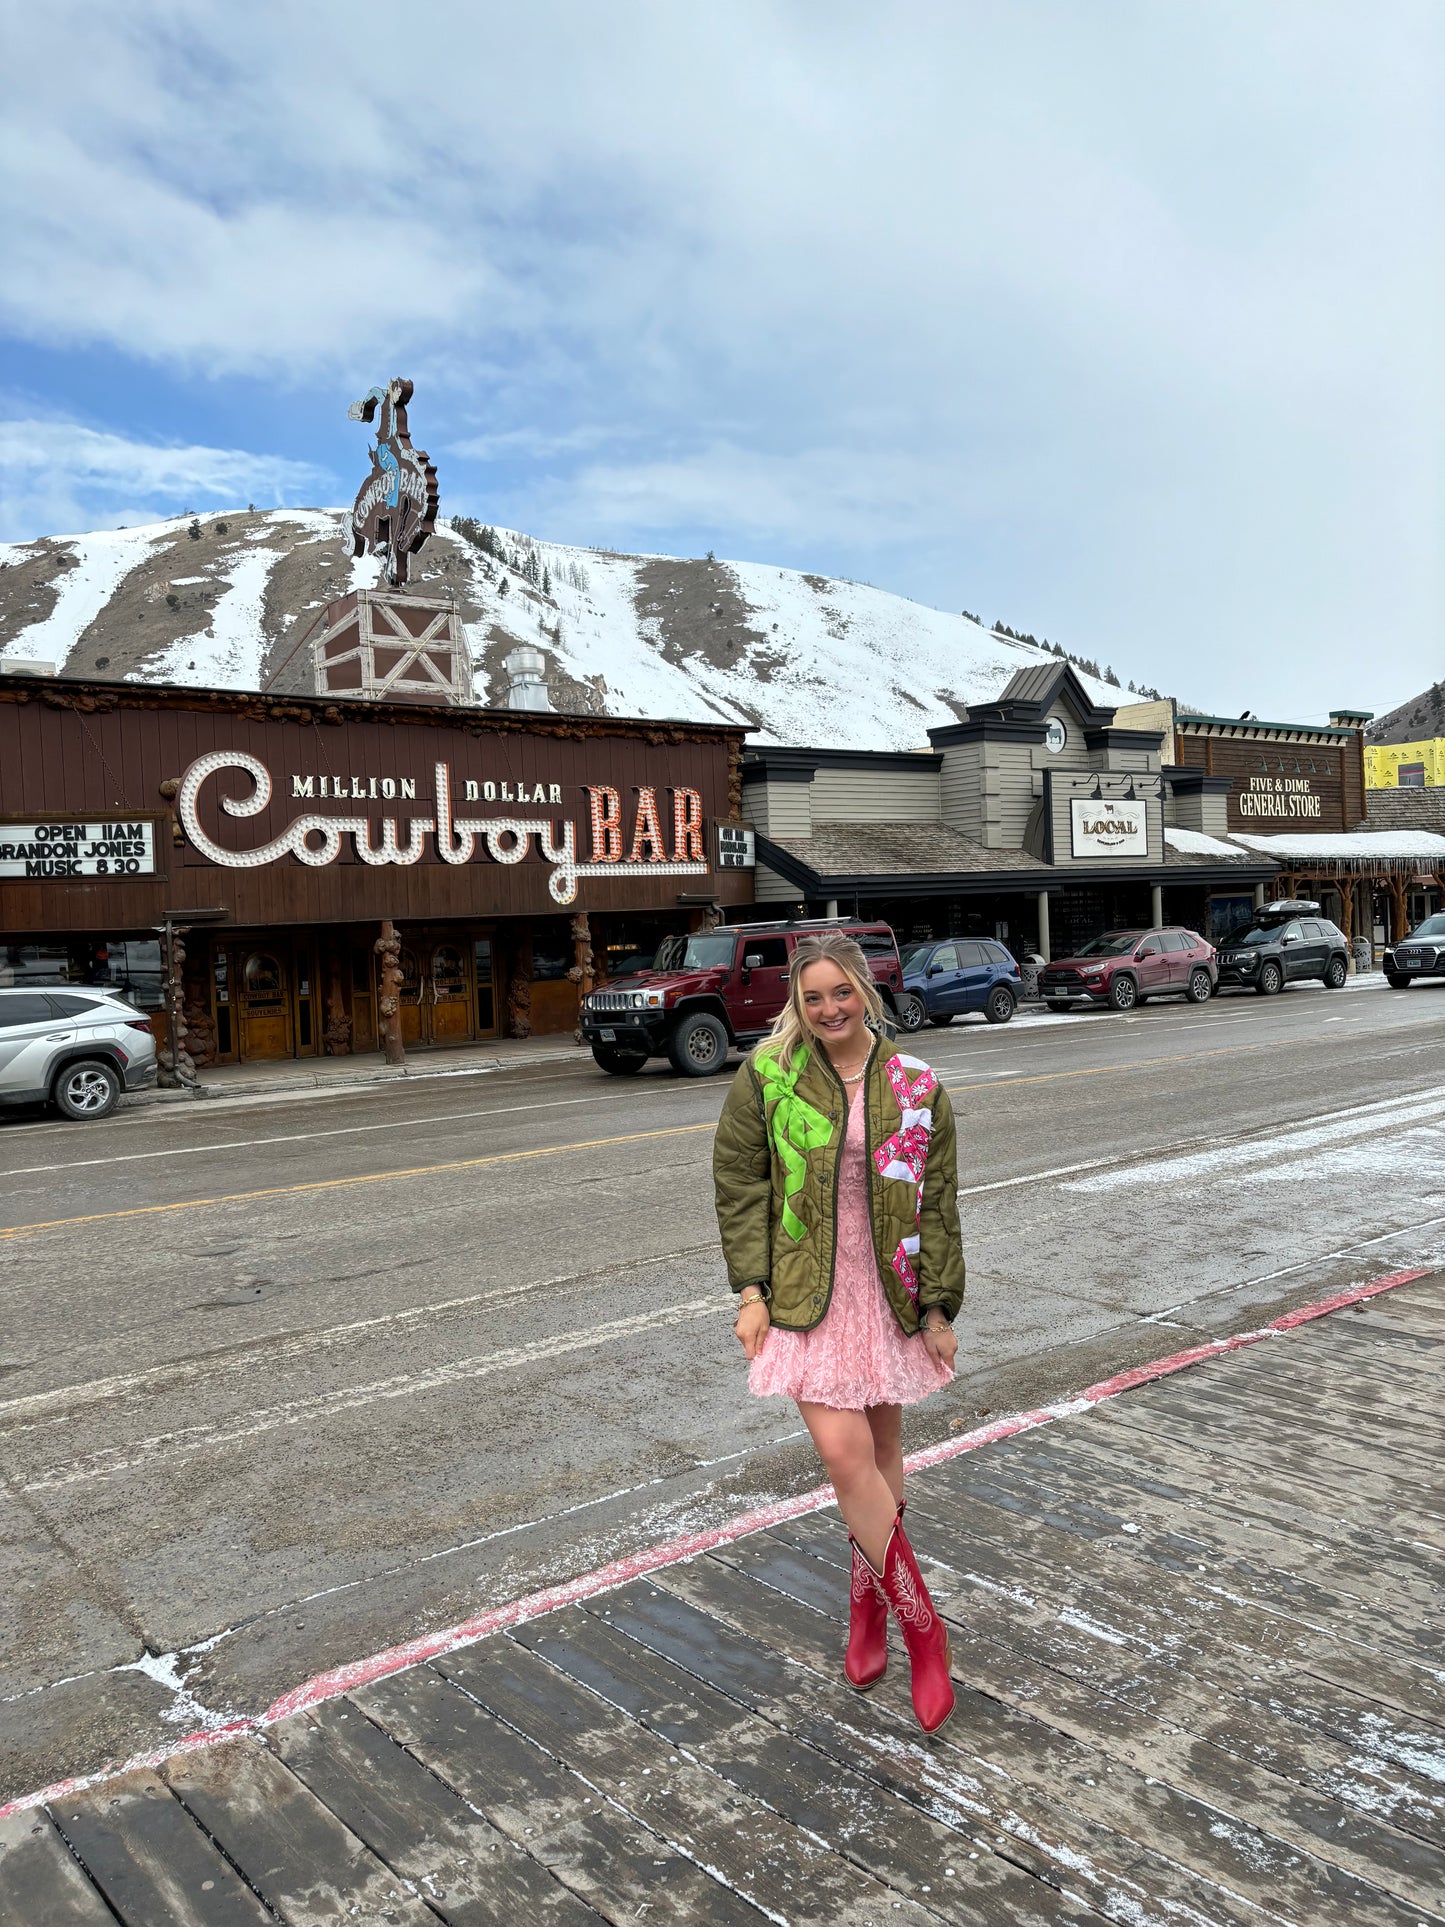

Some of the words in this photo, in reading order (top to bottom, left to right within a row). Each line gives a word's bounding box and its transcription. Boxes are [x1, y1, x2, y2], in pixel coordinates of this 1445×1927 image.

[354, 470, 398, 528] COWBOY
[399, 468, 426, 505] BAR
[291, 775, 416, 799] MILLION
[465, 780, 562, 804] DOLLAR
[1250, 777, 1273, 791] FIVE
[1275, 778, 1283, 792] &
[1284, 779, 1310, 793] DIME
[1240, 793, 1288, 816] GENERAL
[1289, 795, 1321, 817] STORE
[35, 825, 87, 841] OPEN
[180, 751, 577, 904] Cowboy
[582, 785, 707, 863] BAR
[1083, 820, 1138, 834] LOCAL
[0, 842, 79, 860] RANDON
[84, 841, 145, 858] JONES
[26, 859, 82, 876] MUSIC
